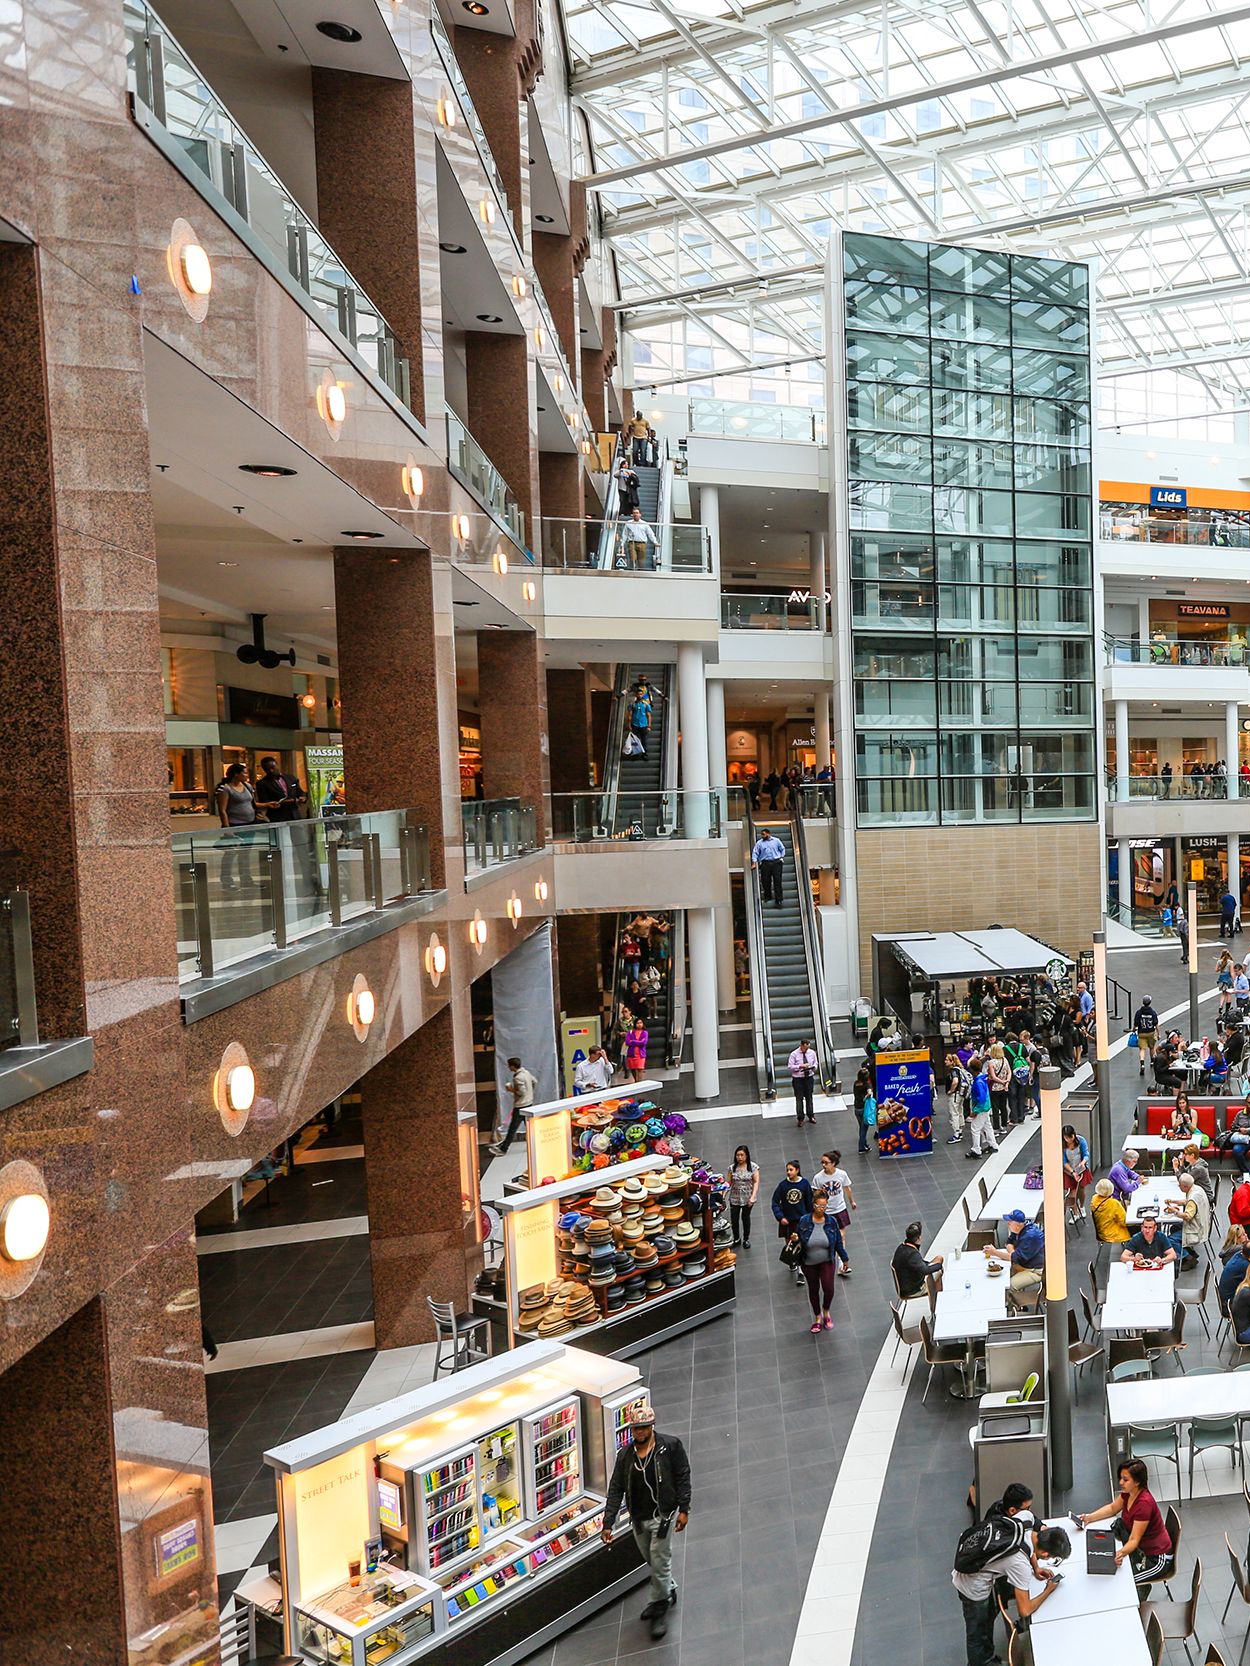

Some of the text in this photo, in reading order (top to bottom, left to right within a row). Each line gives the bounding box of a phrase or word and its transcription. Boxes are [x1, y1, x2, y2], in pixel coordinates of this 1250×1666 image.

[1157, 491, 1183, 503] Lids
[1180, 605, 1227, 615] TEAVANA
[792, 739, 809, 747] Allen
[1189, 838, 1217, 847] LUSH
[301, 1468, 361, 1503] STREET TALK
